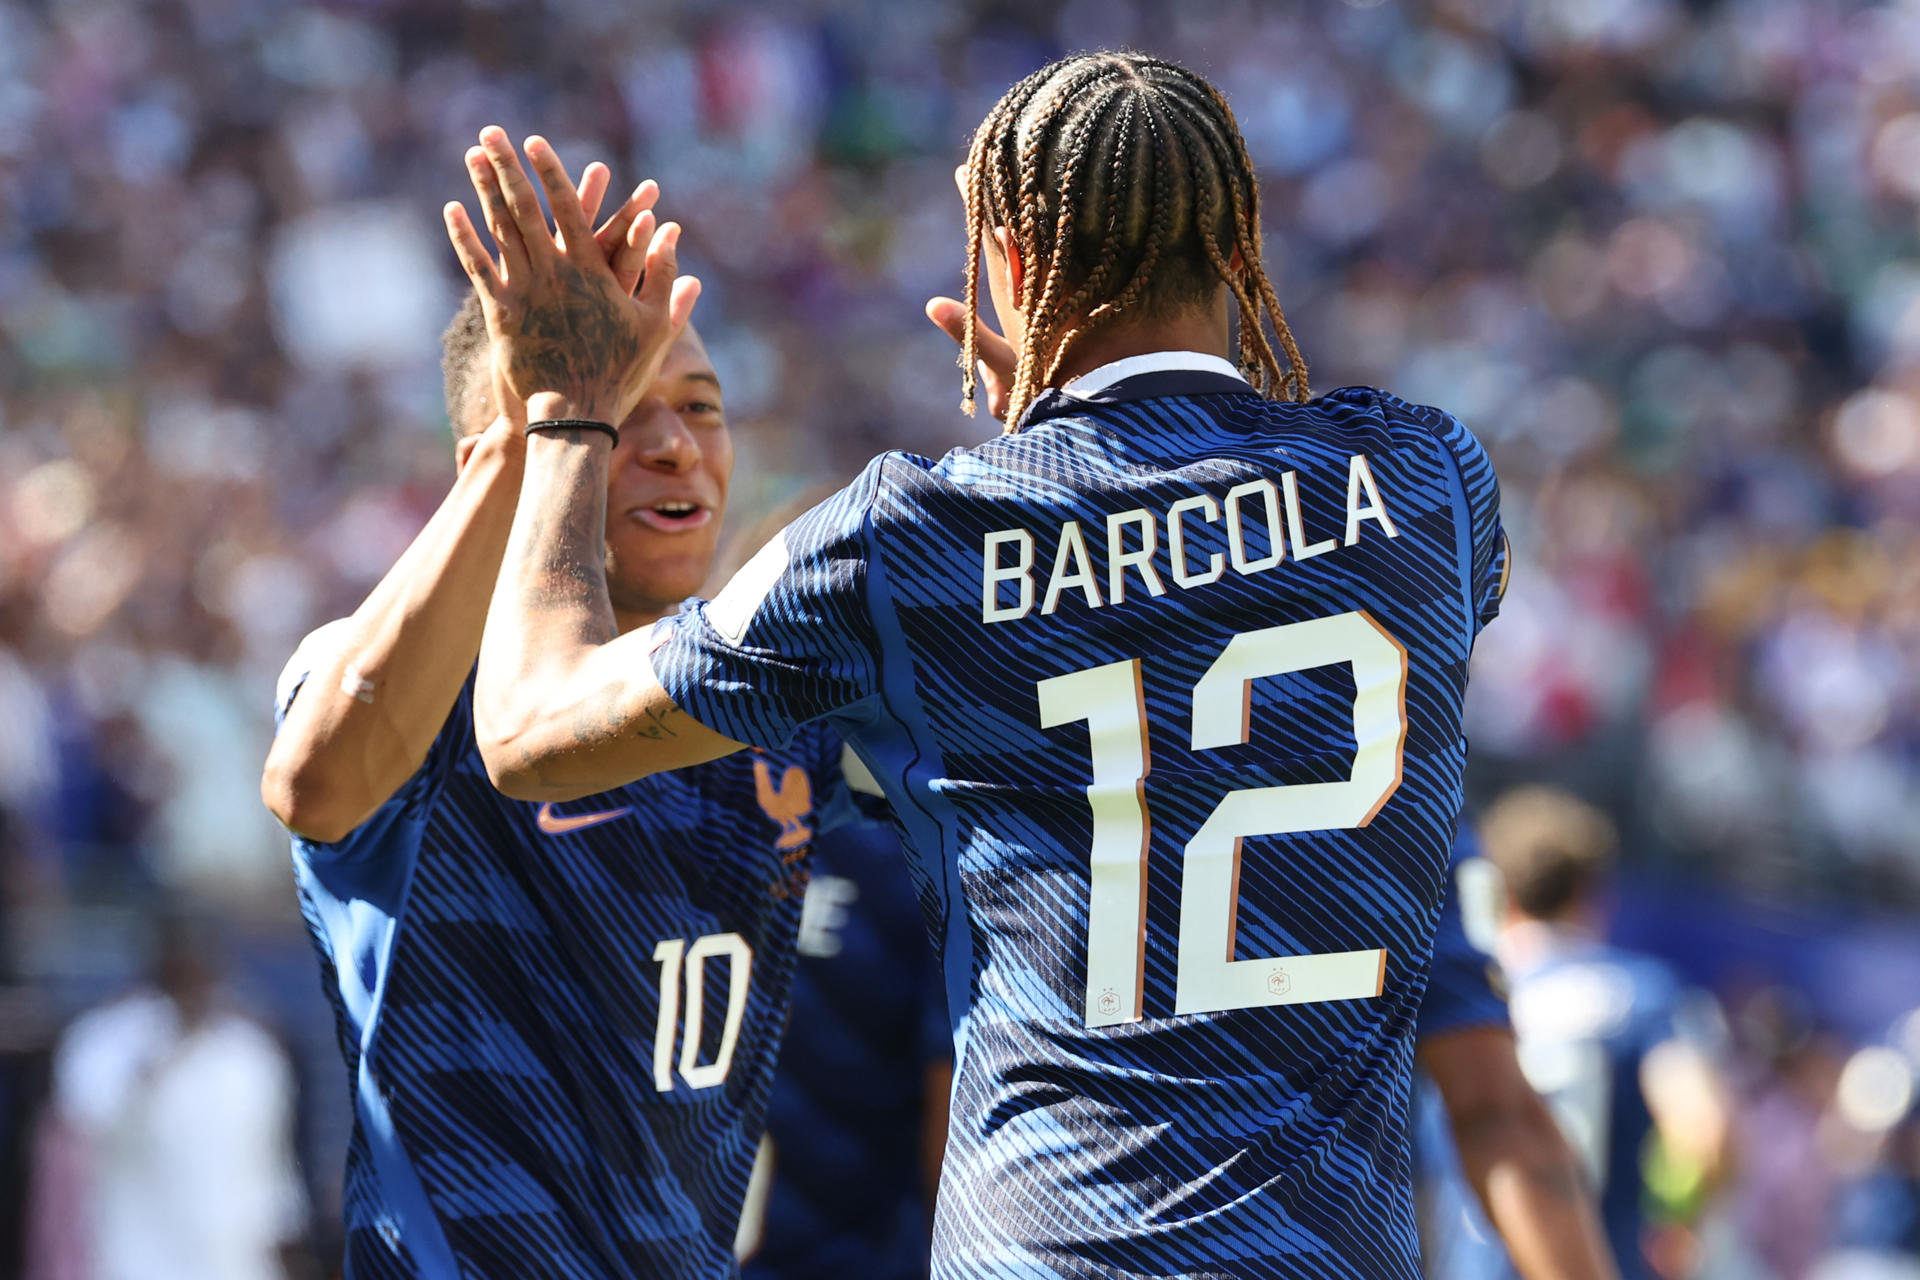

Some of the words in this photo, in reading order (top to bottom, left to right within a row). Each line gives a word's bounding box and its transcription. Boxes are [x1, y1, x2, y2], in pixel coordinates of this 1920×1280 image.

[983, 454, 1399, 624] BARCOLA
[1036, 610, 1407, 1028] 12
[652, 932, 753, 1092] 10
